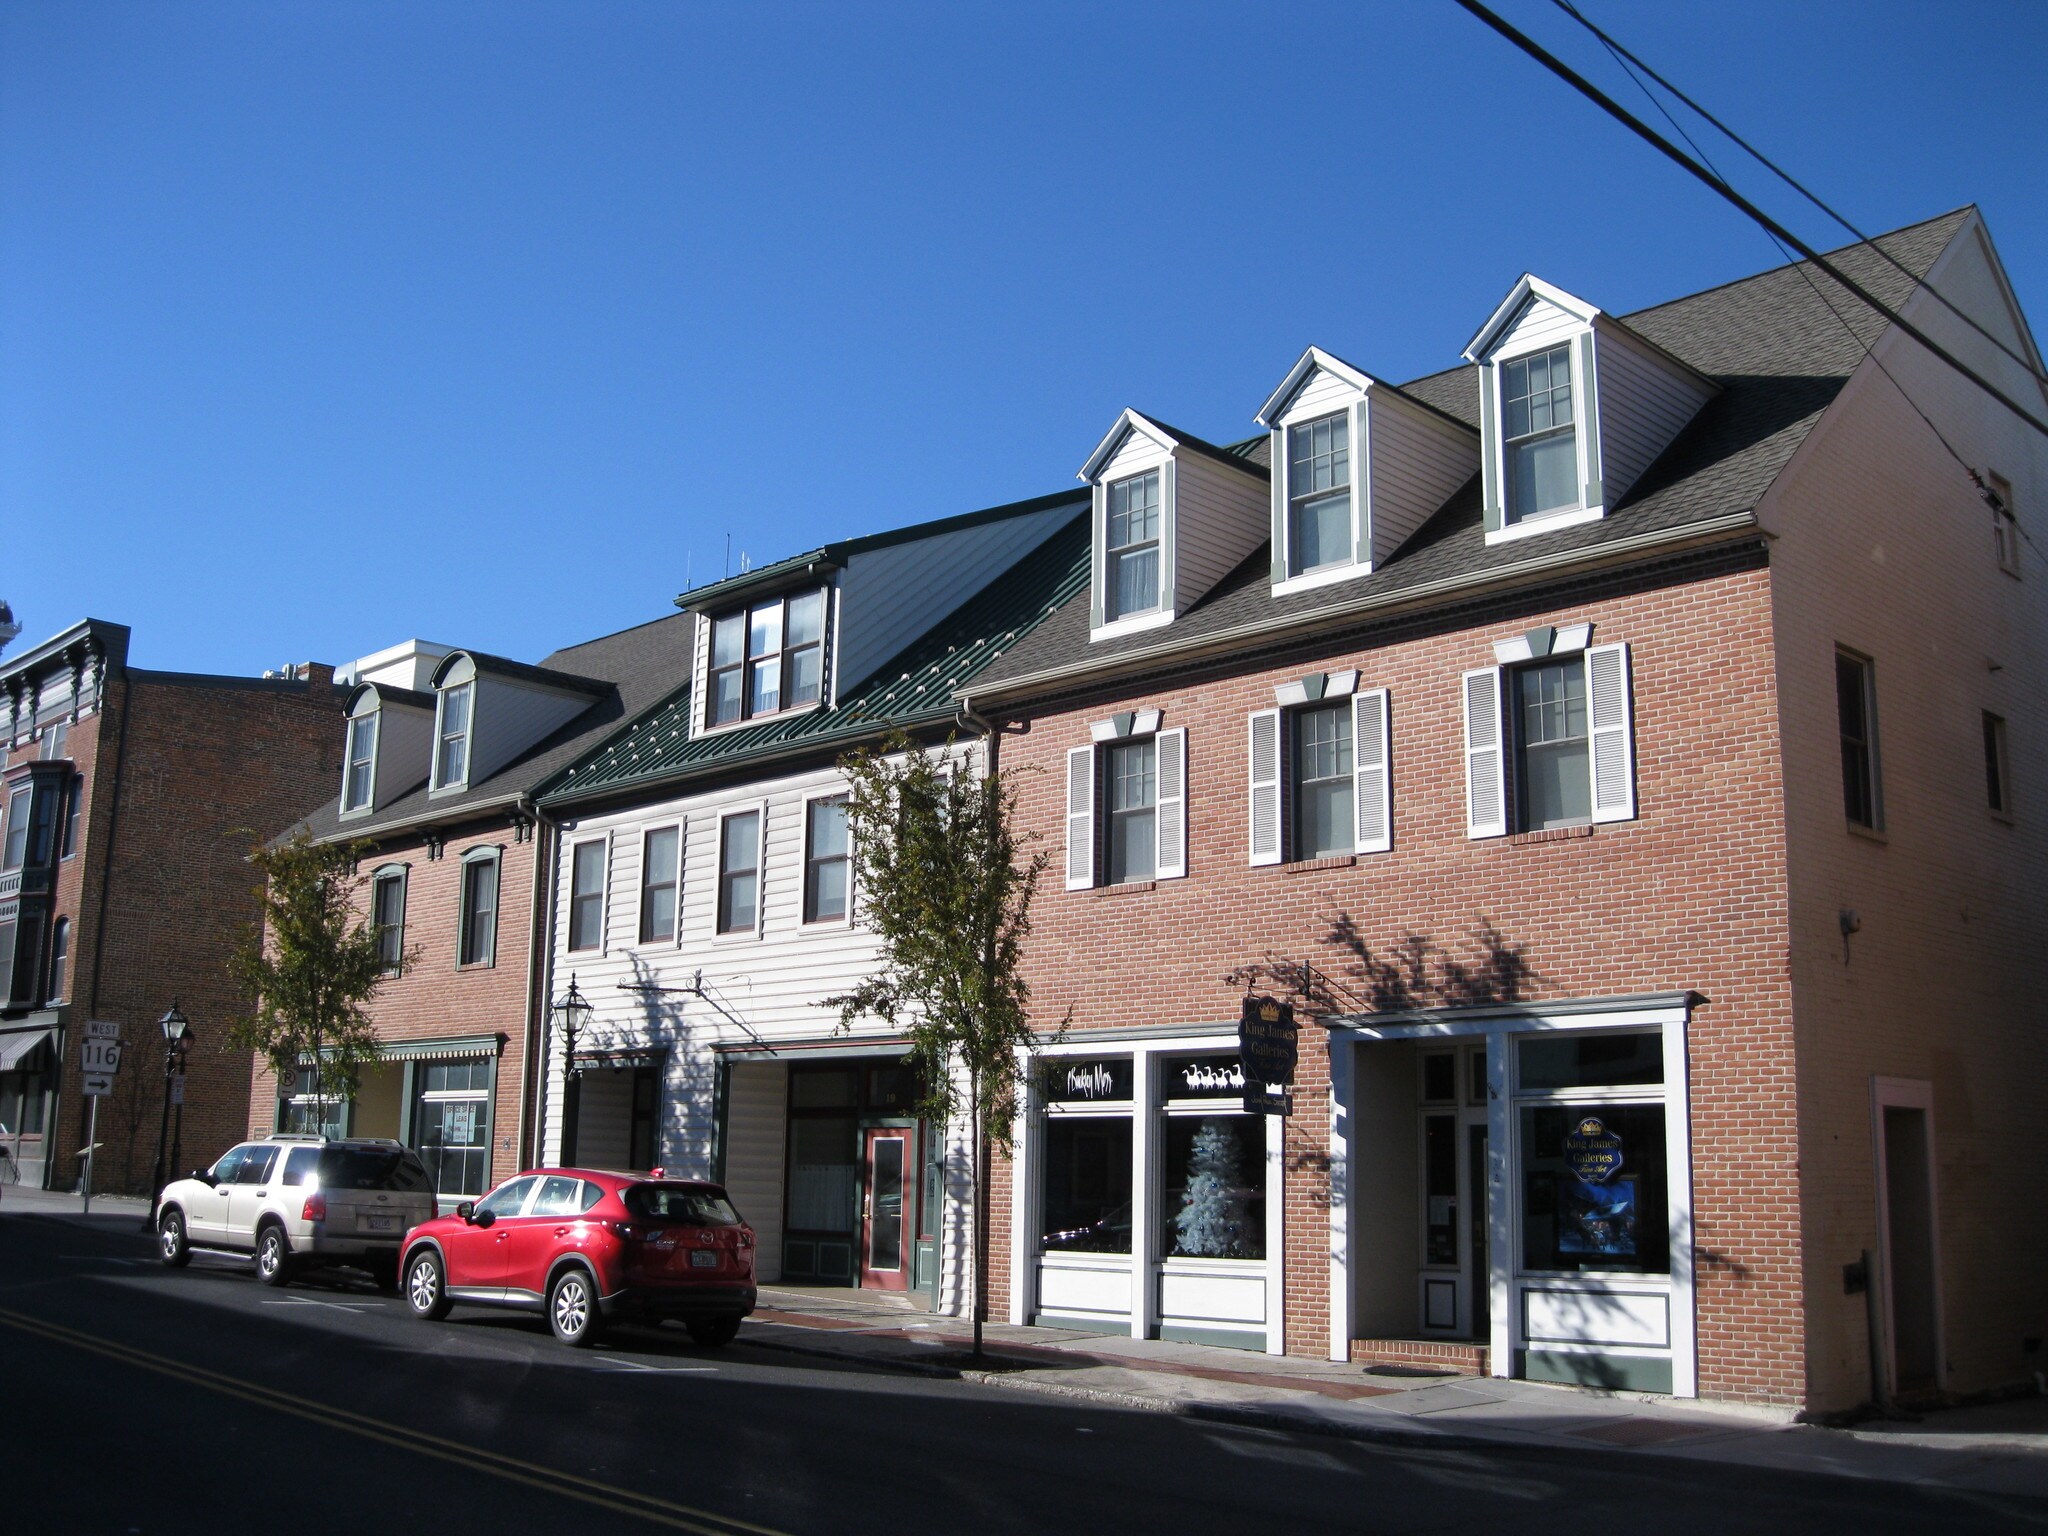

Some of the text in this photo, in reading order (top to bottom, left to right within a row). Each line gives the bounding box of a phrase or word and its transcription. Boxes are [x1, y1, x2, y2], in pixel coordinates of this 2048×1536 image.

[91, 1023, 117, 1034] WEST
[1245, 1021, 1295, 1040] King James
[86, 1045, 117, 1065] 116
[1251, 1041, 1289, 1058] Galleries
[1566, 1139, 1618, 1149] King James
[1573, 1152, 1613, 1163] Galleries
